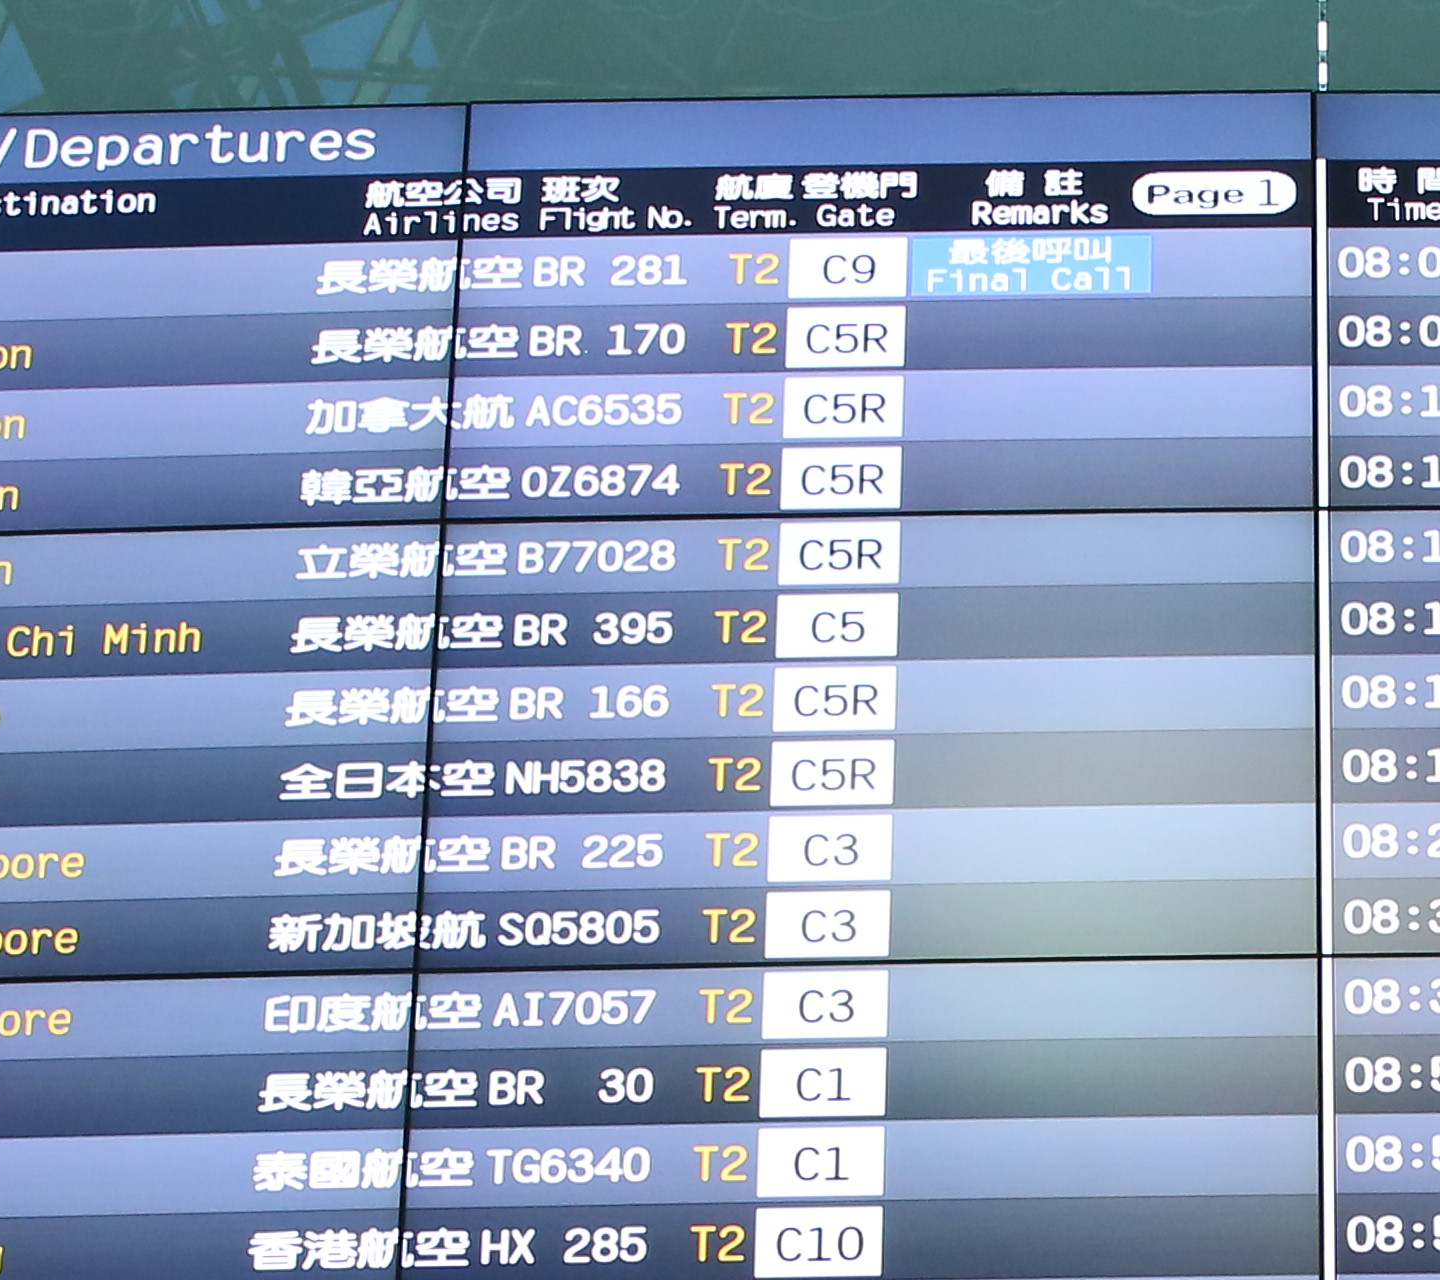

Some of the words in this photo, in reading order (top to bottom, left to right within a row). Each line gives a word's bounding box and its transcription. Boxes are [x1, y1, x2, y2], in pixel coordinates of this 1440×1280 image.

[364, 177, 522, 209] 航空公司
[541, 174, 620, 204] 班次
[801, 171, 918, 200] 登機門
[1147, 184, 1244, 209] Page
[1259, 179, 1279, 207] 1
[363, 210, 519, 236] Airlines
[539, 206, 636, 233] Flight
[647, 205, 692, 229] No.
[713, 205, 797, 229] Term.
[816, 203, 895, 228] Gate
[971, 199, 1109, 226] Remarks
[948, 236, 1112, 266] 最後呼叫
[315, 254, 524, 295] 長榮航空
[533, 255, 586, 287] BR
[610, 254, 687, 286] 281
[729, 253, 779, 285] T2
[823, 254, 876, 285] C9
[927, 267, 1027, 293] Final
[1051, 266, 1131, 291] Call
[7, 624, 74, 657] Chi
[103, 621, 201, 655] Minh
[290, 612, 504, 654] 長榮航空
[513, 613, 568, 647] BR
[593, 611, 673, 645] 395
[714, 610, 767, 644] T2
[811, 611, 865, 643] C5
